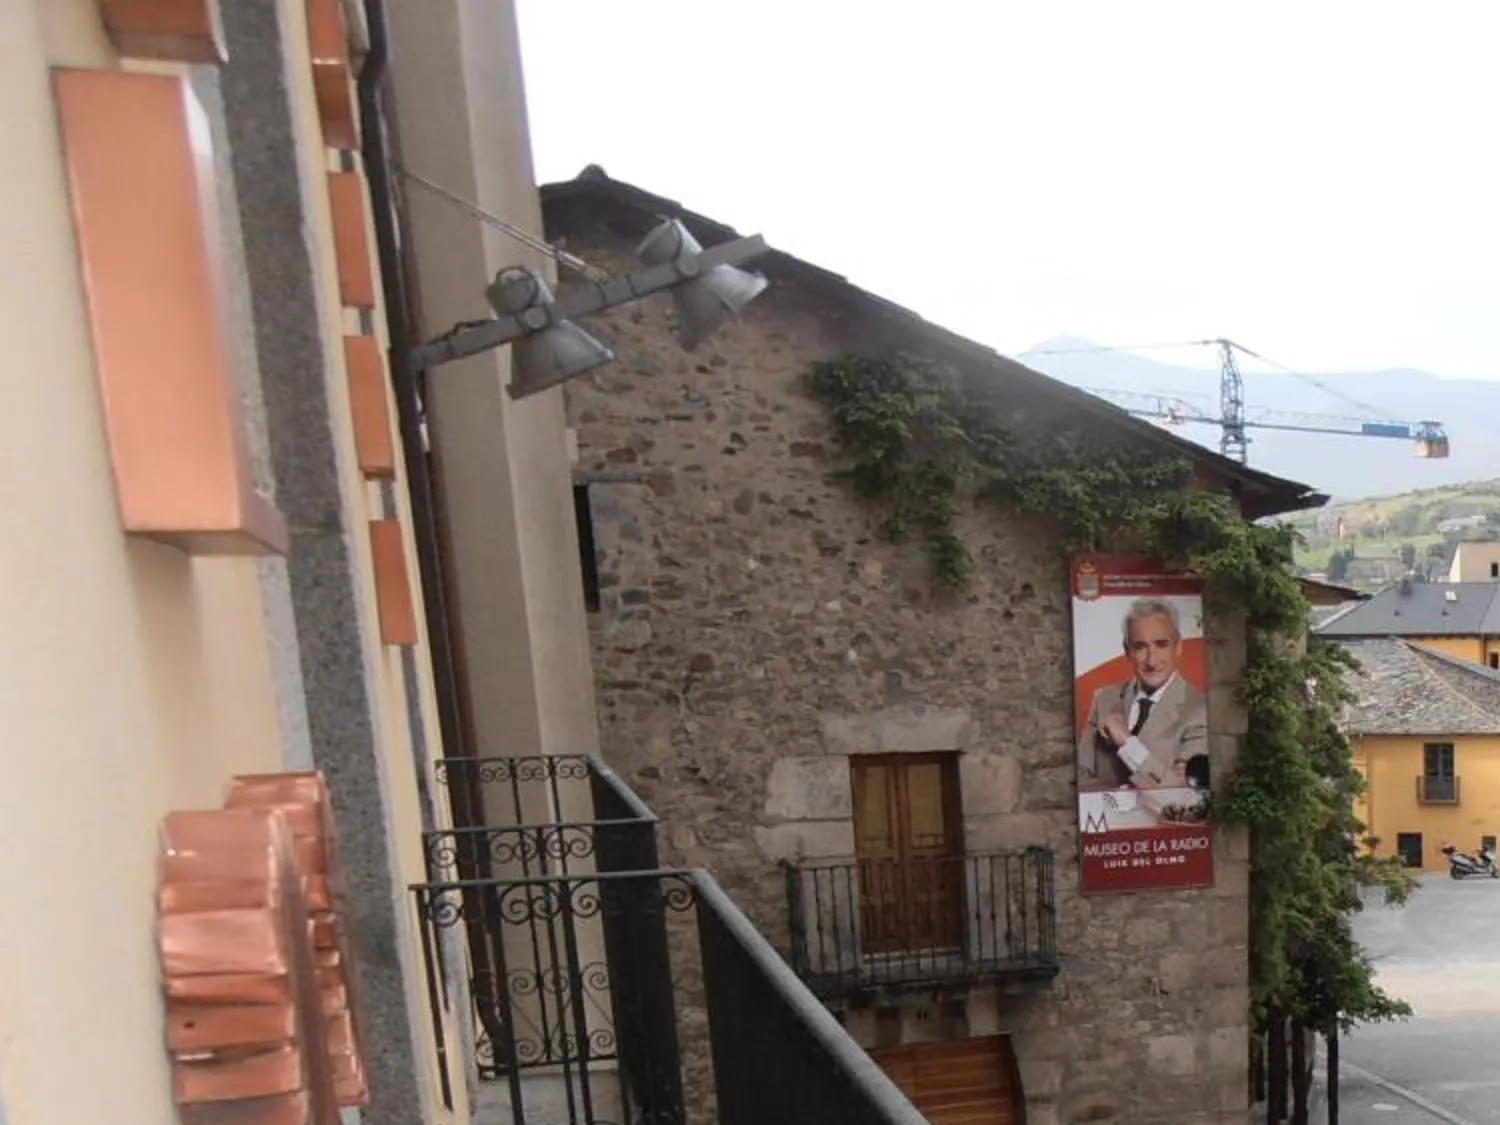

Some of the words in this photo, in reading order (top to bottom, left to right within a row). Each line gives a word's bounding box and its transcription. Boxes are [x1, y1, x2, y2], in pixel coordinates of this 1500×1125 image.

[1083, 841, 1131, 857] MUSEO
[1133, 840, 1150, 854] DE
[1153, 839, 1168, 853] LA
[1170, 836, 1209, 851] RADIO
